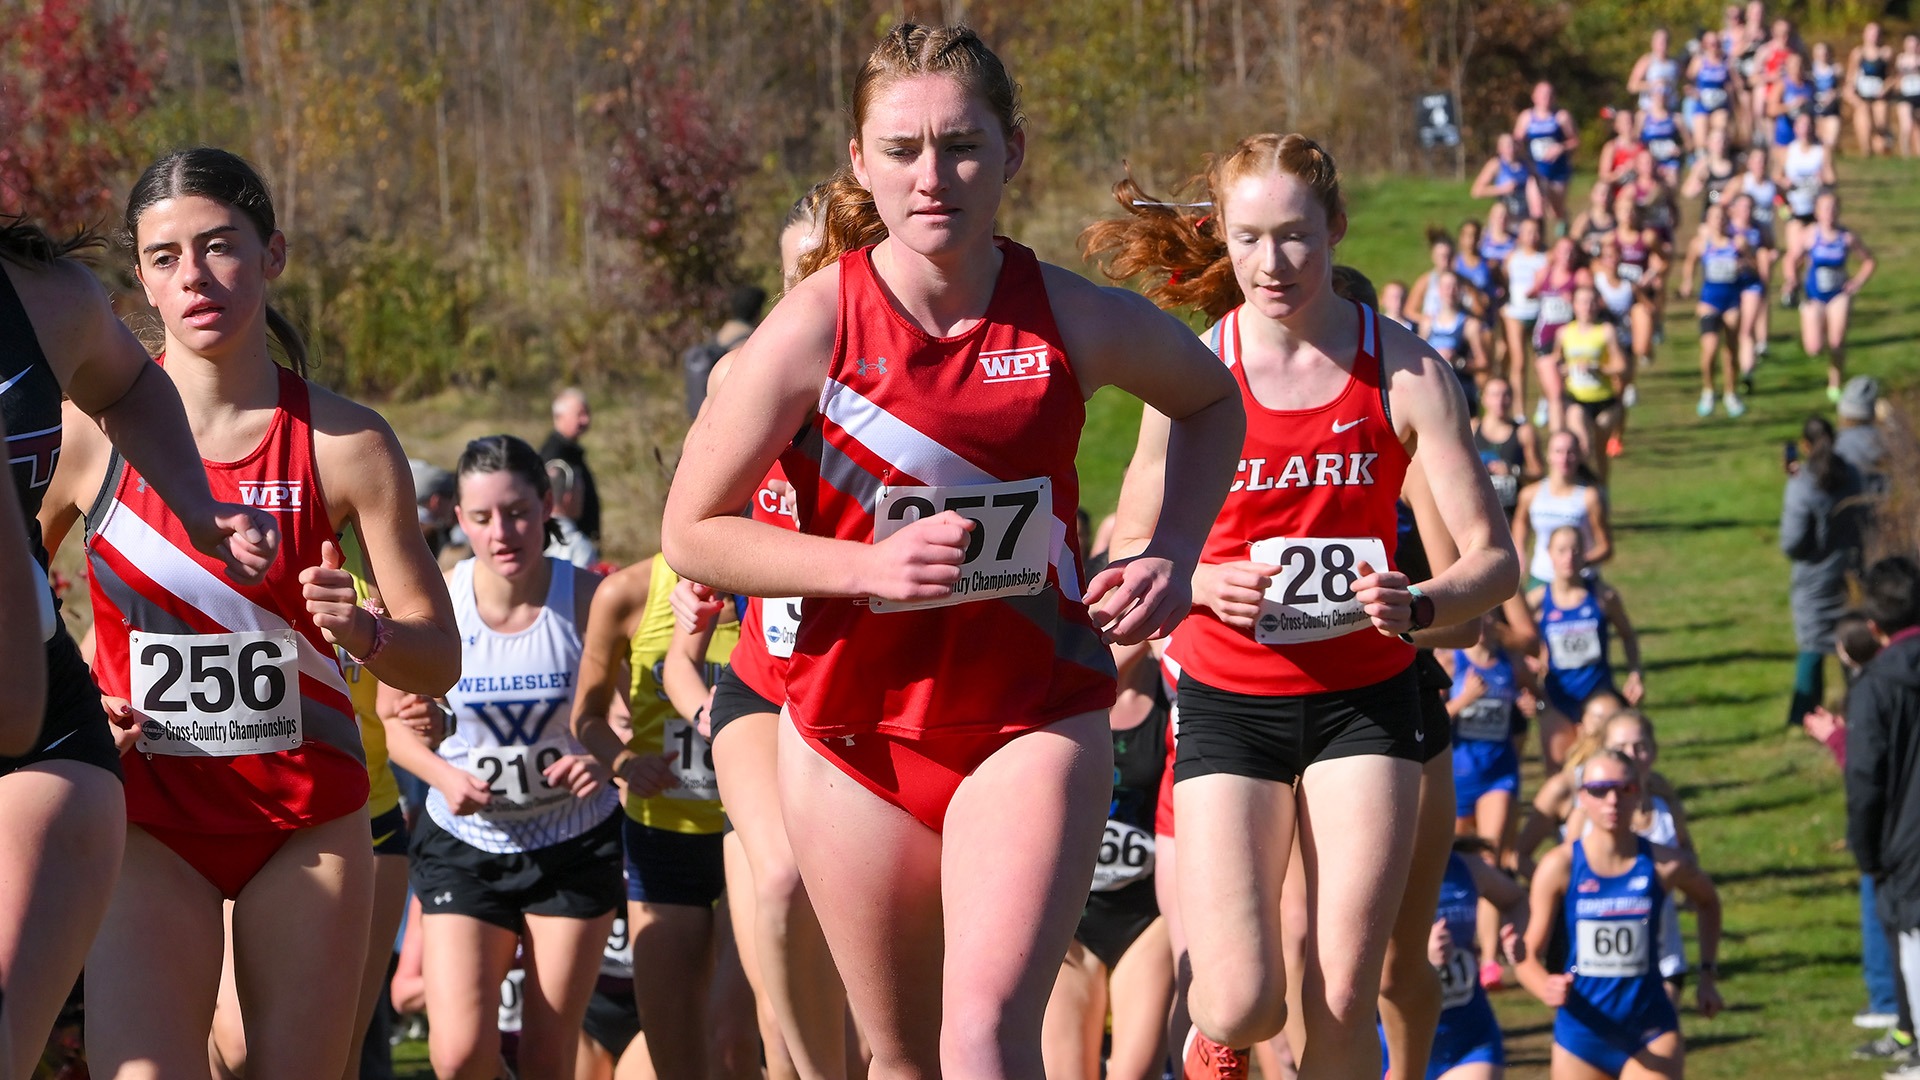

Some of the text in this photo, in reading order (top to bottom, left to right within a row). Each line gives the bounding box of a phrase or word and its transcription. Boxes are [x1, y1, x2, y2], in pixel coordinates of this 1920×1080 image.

[979, 350, 1050, 378] WPI
[1230, 453, 1379, 493] CLARK
[239, 486, 301, 506] WPI
[972, 567, 1041, 592] Championships
[1280, 544, 1358, 606] 28
[1281, 611, 1331, 632] Cross-Country
[140, 641, 286, 713] 256
[457, 672, 572, 693] WELLESLEY
[165, 716, 297, 744] Cross-Country Championships
[464, 697, 569, 746] W
[477, 746, 563, 796] 219
[1594, 927, 1633, 957] 60
